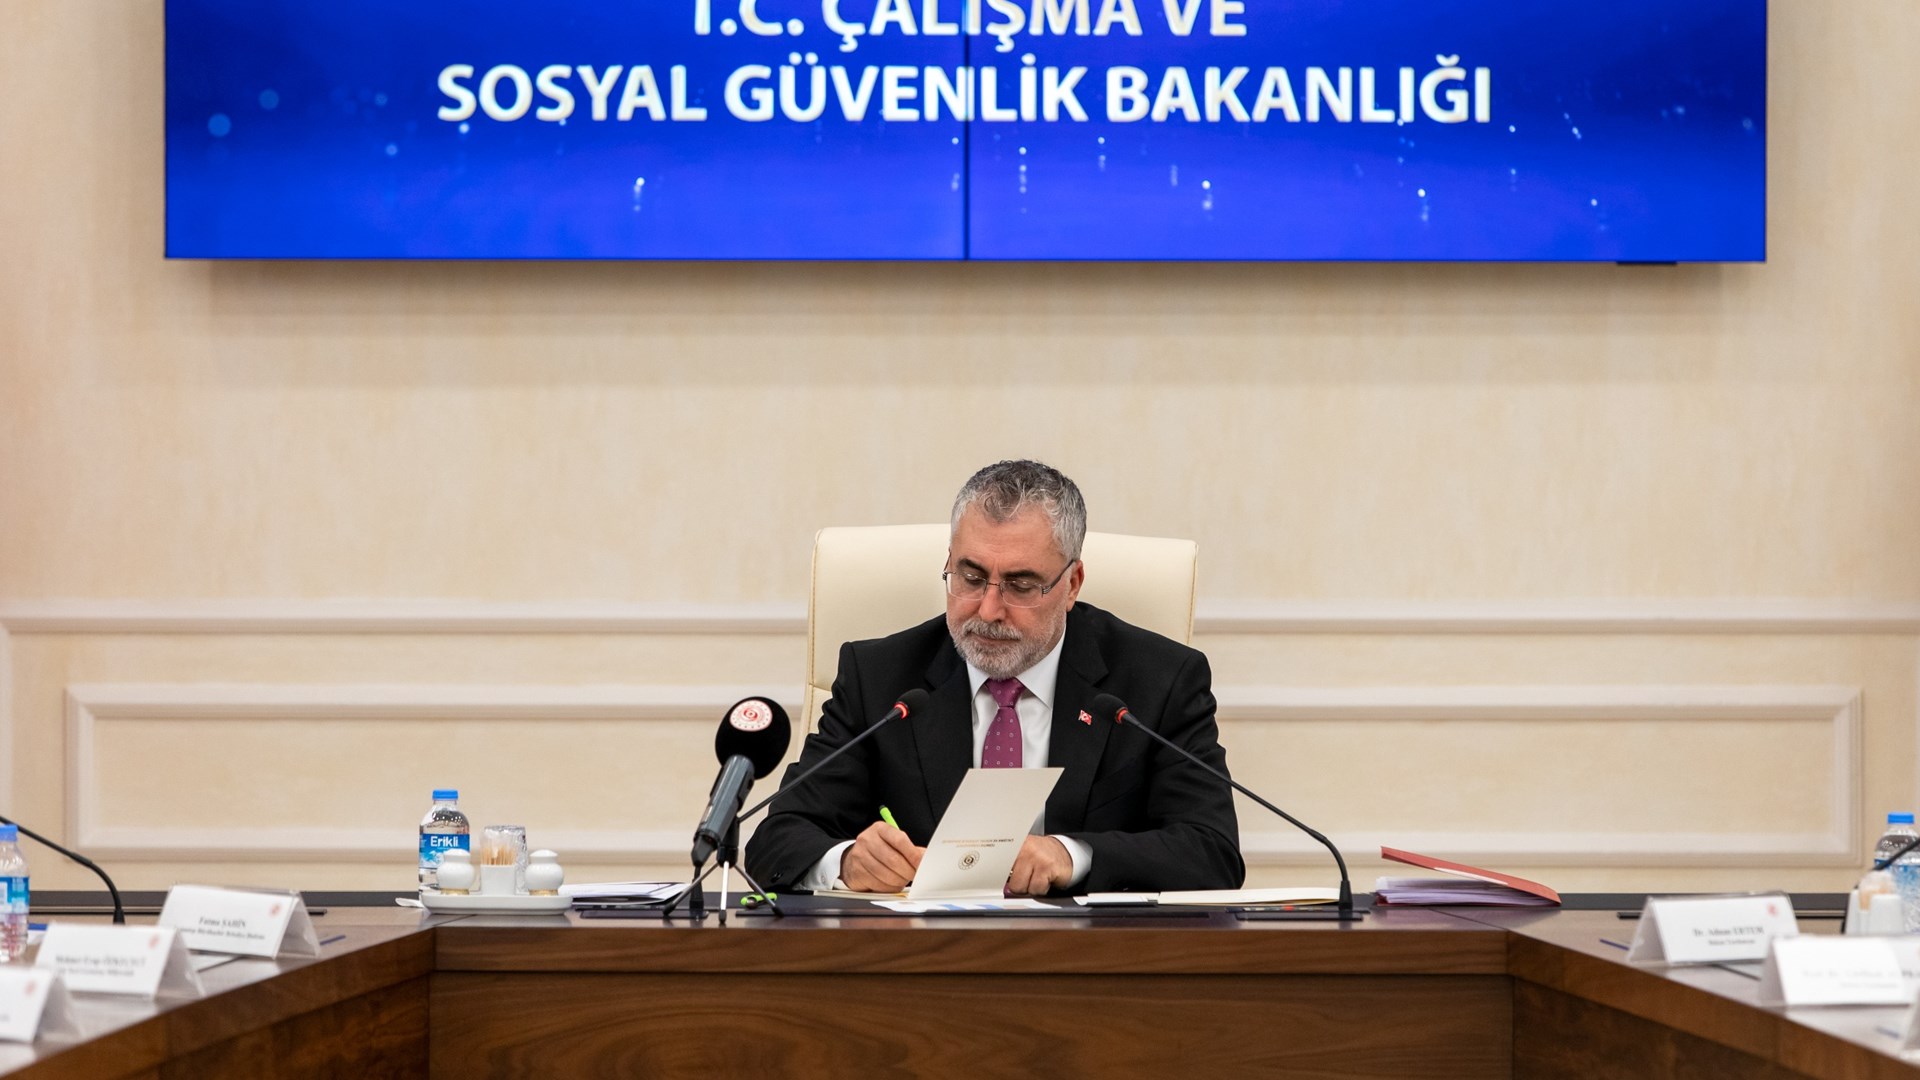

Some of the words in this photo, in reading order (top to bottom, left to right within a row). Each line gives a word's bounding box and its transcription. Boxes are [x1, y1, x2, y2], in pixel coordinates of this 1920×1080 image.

[821, 0, 1144, 53] ÇALIŞMA
[1161, 0, 1248, 36] VE
[437, 64, 708, 122] SOSYAL
[723, 52, 1089, 122] GÜVENLİK
[1105, 54, 1492, 123] BAKANLIĞI
[430, 836, 459, 847] Erikli
